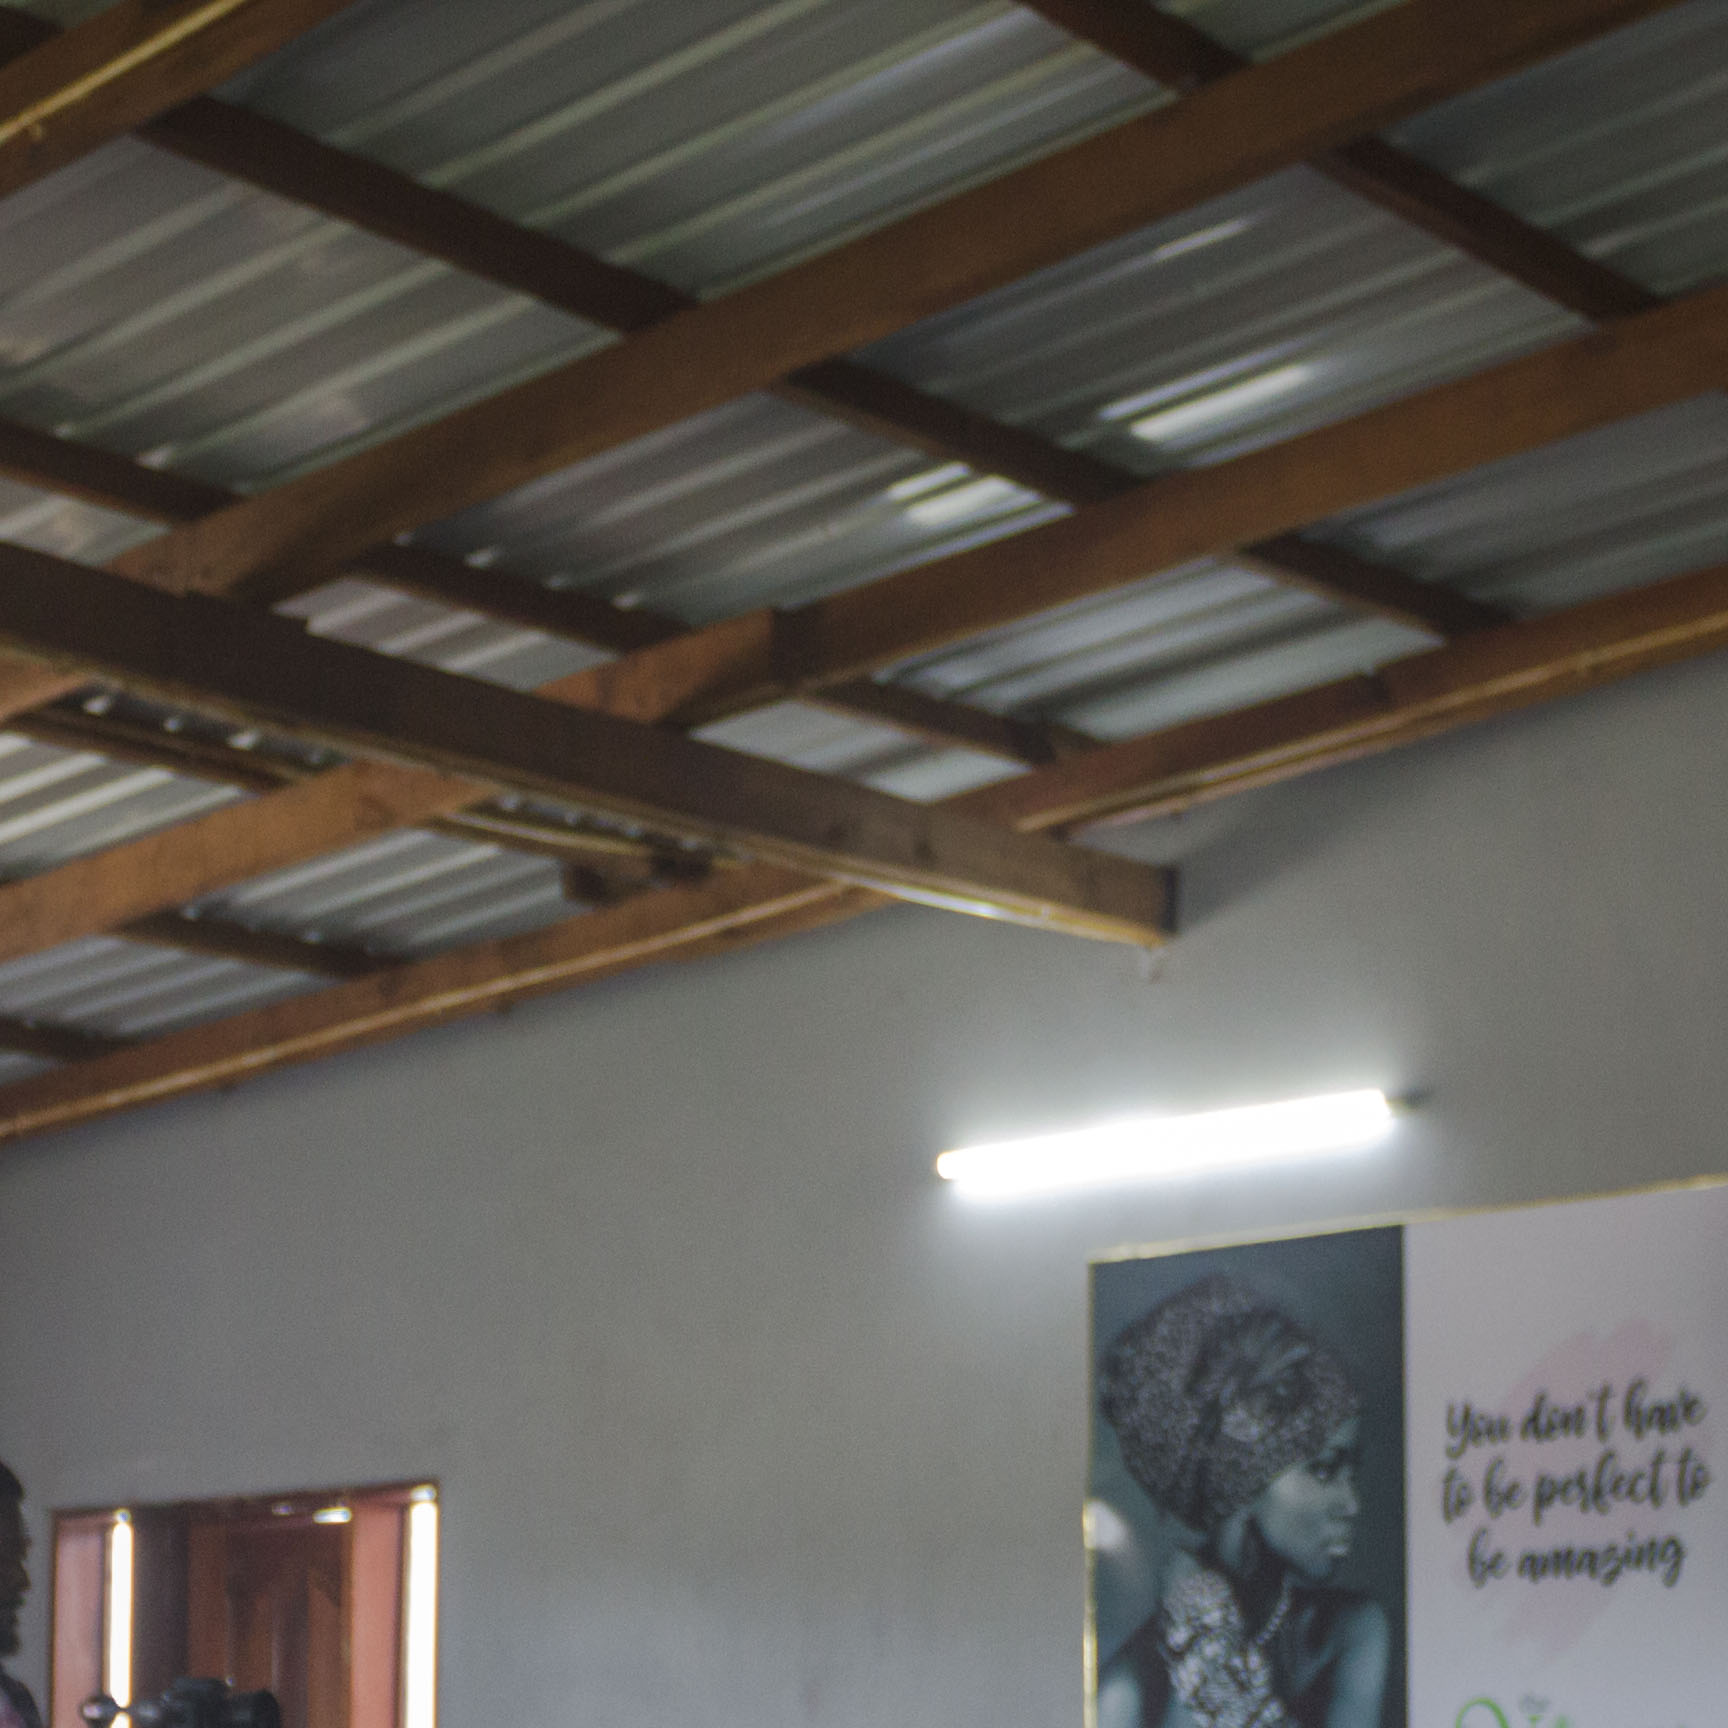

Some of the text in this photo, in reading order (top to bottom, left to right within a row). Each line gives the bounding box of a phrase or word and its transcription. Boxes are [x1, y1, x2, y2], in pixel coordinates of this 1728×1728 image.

[1520, 1385, 1616, 1443] don't
[1625, 1377, 1708, 1440] have
[1443, 1448, 1710, 1526] to be perfect to
[1468, 1527, 1685, 1588] be amazing
